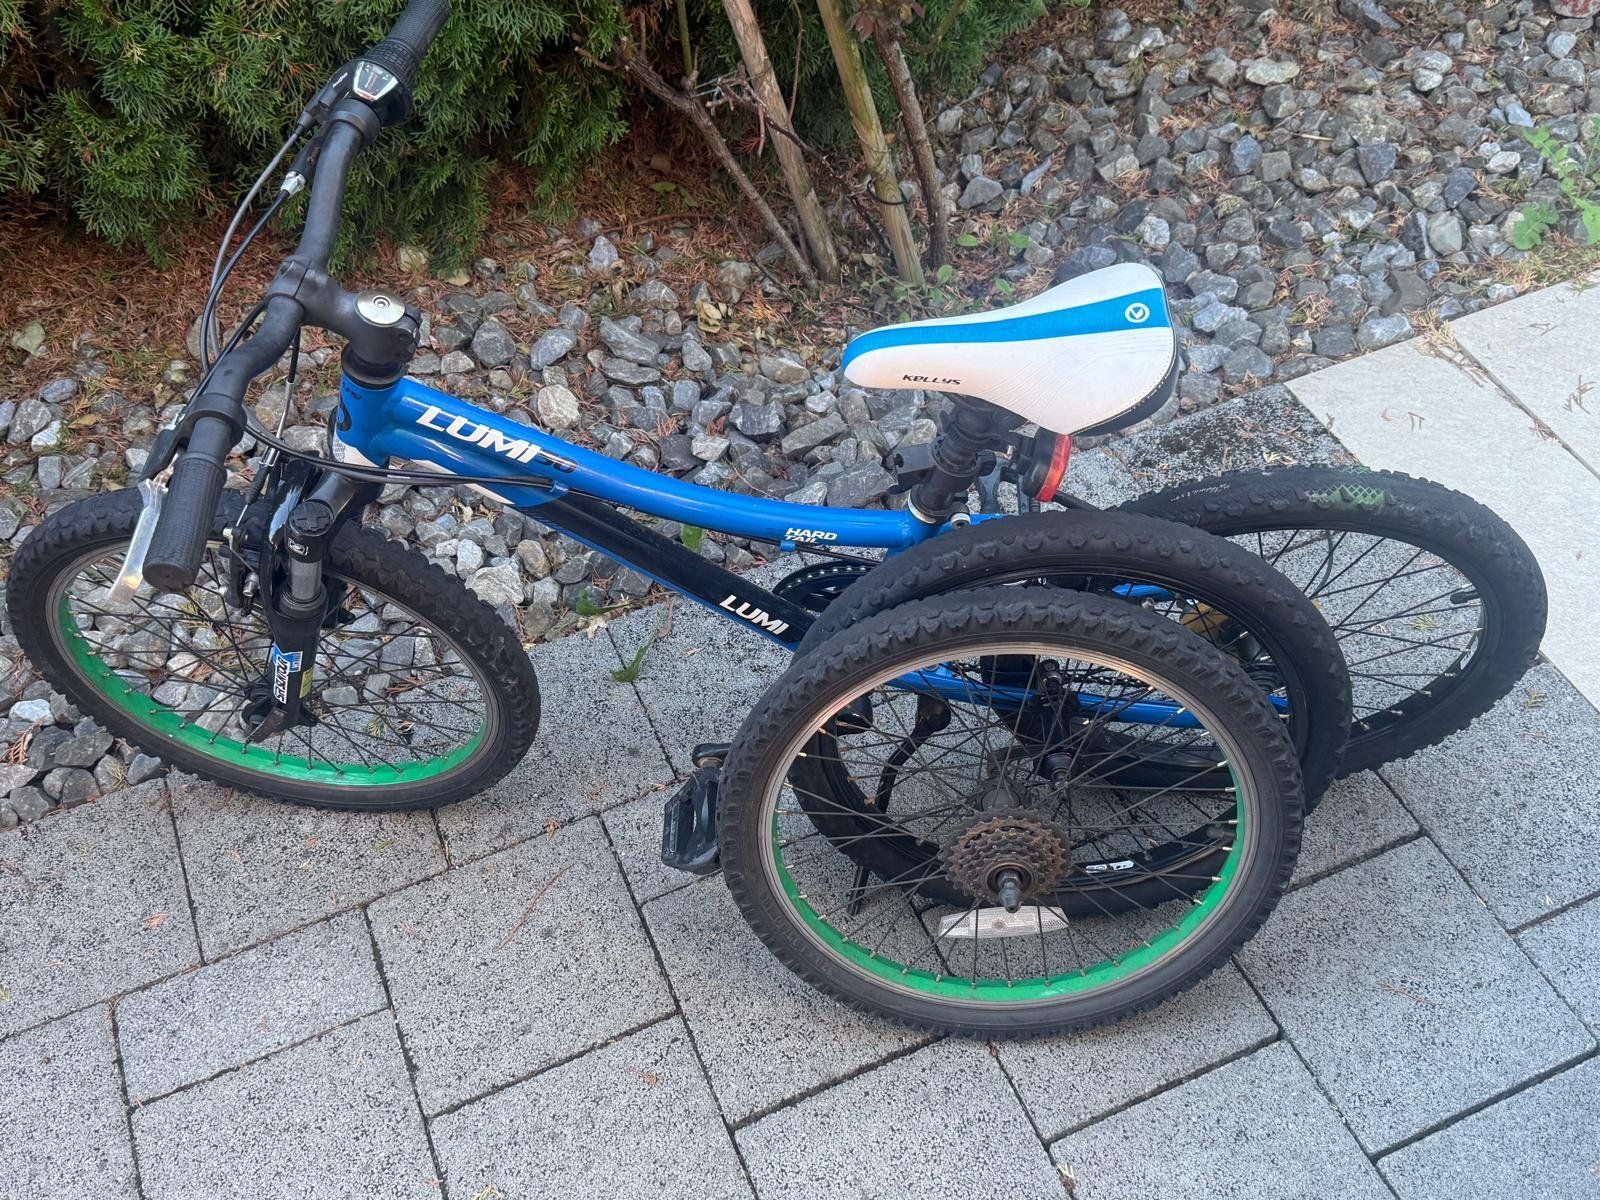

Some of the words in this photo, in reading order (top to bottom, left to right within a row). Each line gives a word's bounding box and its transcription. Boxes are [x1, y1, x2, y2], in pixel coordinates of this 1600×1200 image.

[416, 405, 541, 463] LUMI
[785, 535, 819, 544] TAIL
[786, 528, 838, 541] HARD
[719, 594, 790, 635] LUMI
